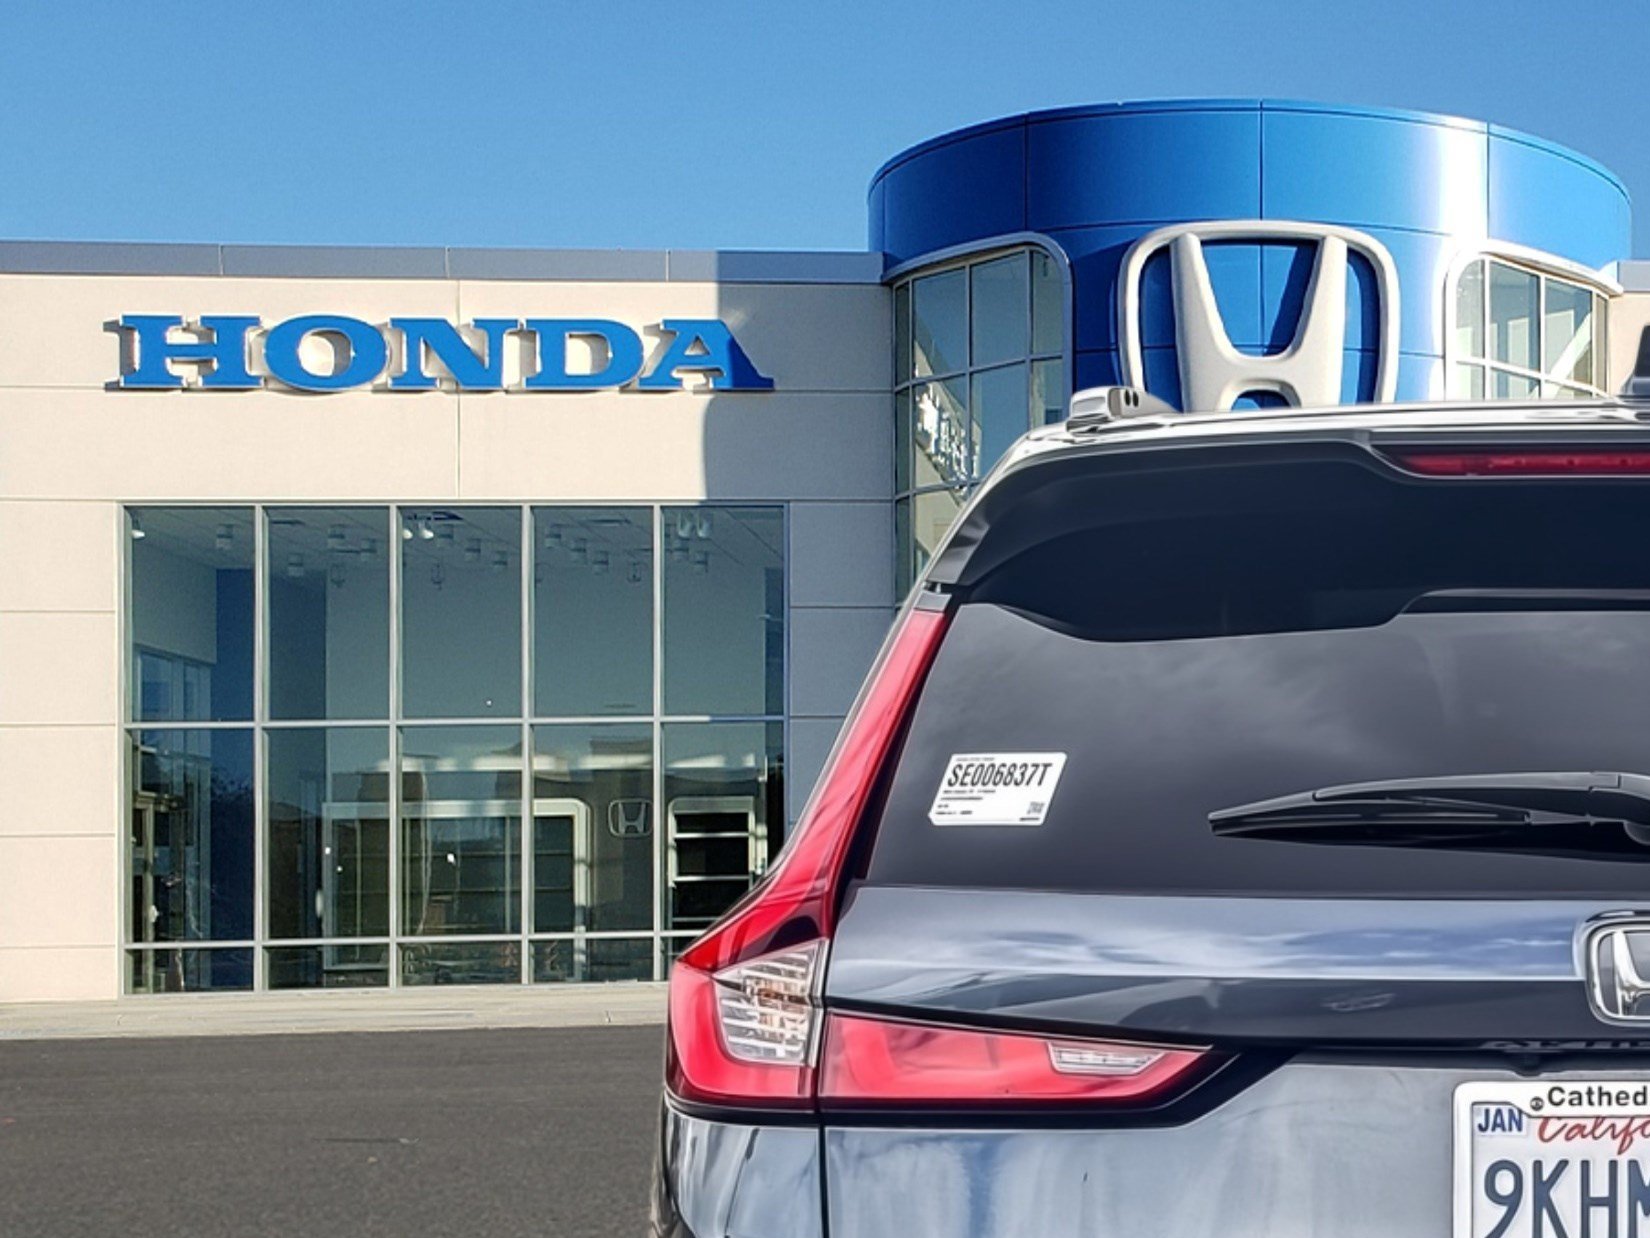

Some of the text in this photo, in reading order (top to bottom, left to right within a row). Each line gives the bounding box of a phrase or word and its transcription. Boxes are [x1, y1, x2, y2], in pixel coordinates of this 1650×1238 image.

[105, 314, 775, 392] HONDA
[948, 762, 1053, 788] SE006837T
[1477, 1106, 1524, 1133] JAN
